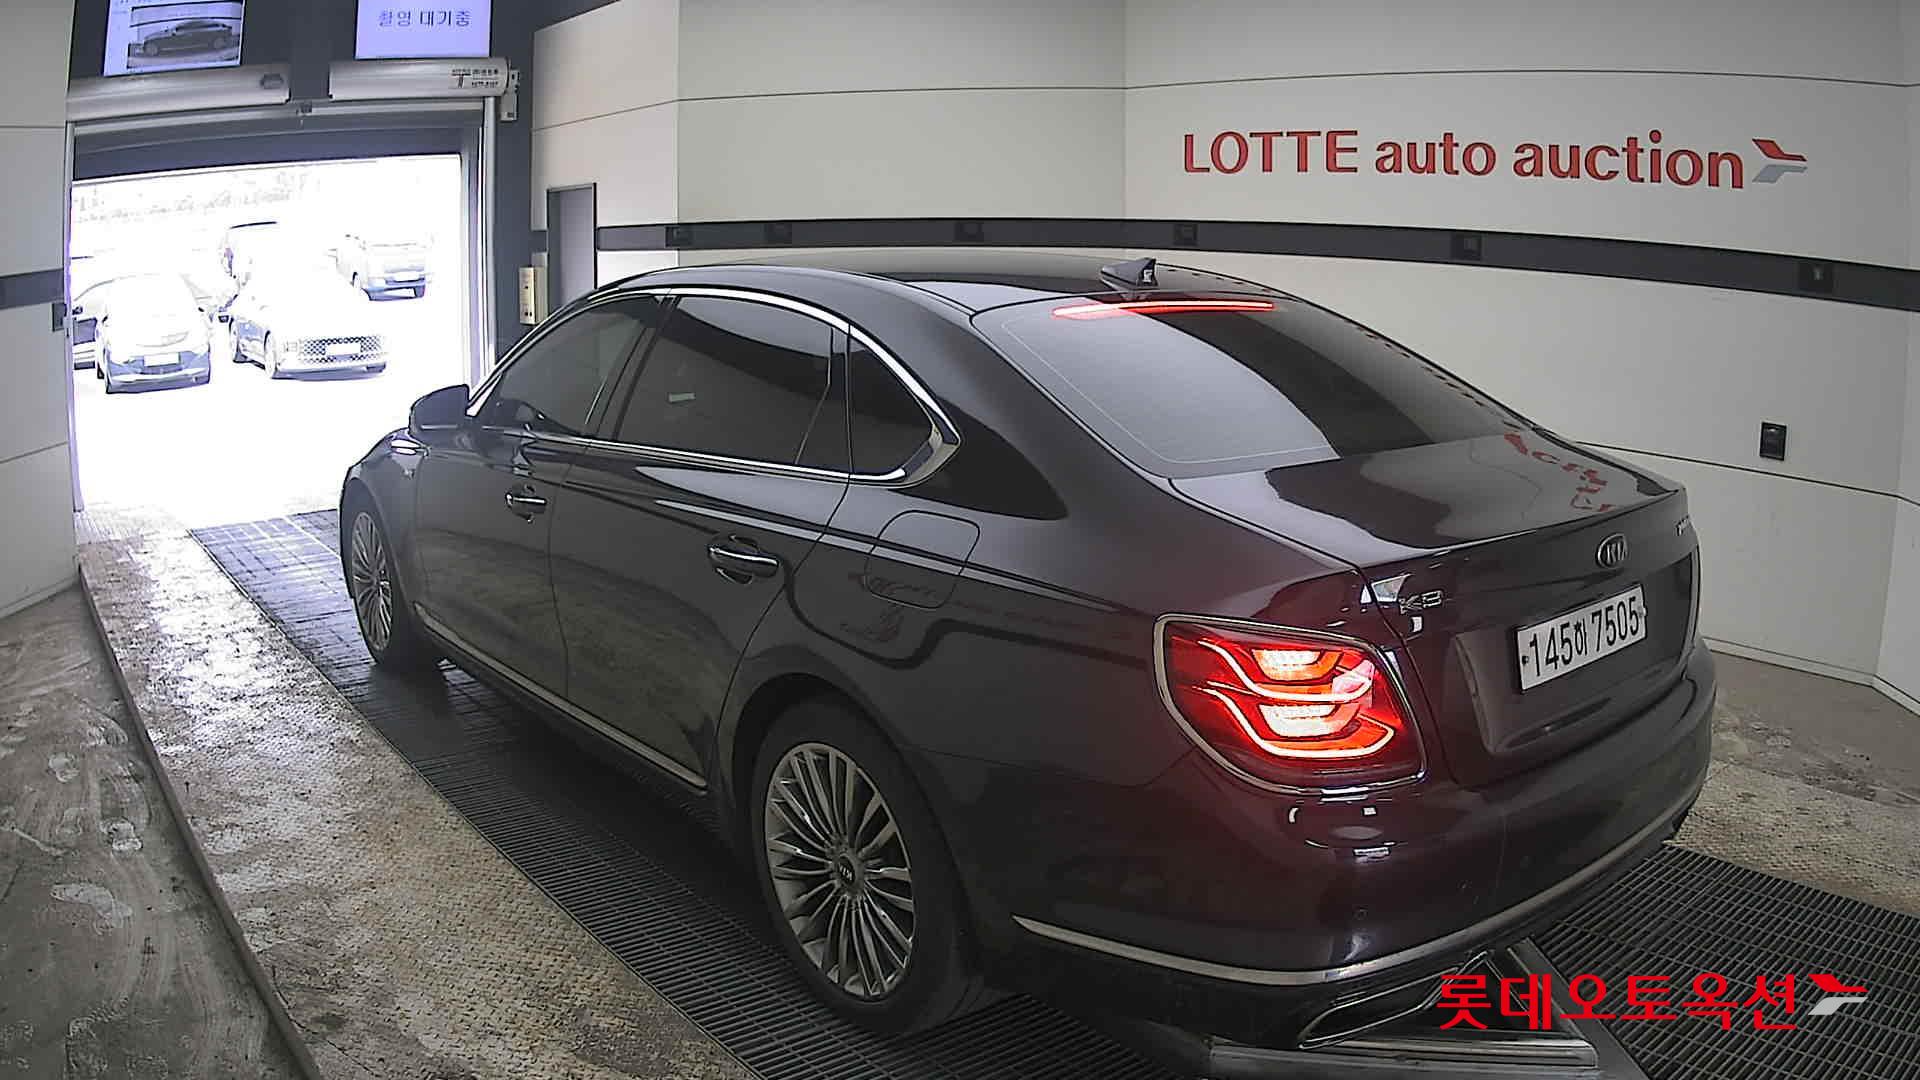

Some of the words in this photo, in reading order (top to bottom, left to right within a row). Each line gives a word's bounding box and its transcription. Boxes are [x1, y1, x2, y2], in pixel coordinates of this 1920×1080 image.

[420, 9, 470, 27] 대기중
[1184, 130, 1358, 175] LOTTE
[1375, 132, 1496, 176] auto
[1513, 129, 1744, 189] auction
[1591, 596, 1639, 653] 7505
